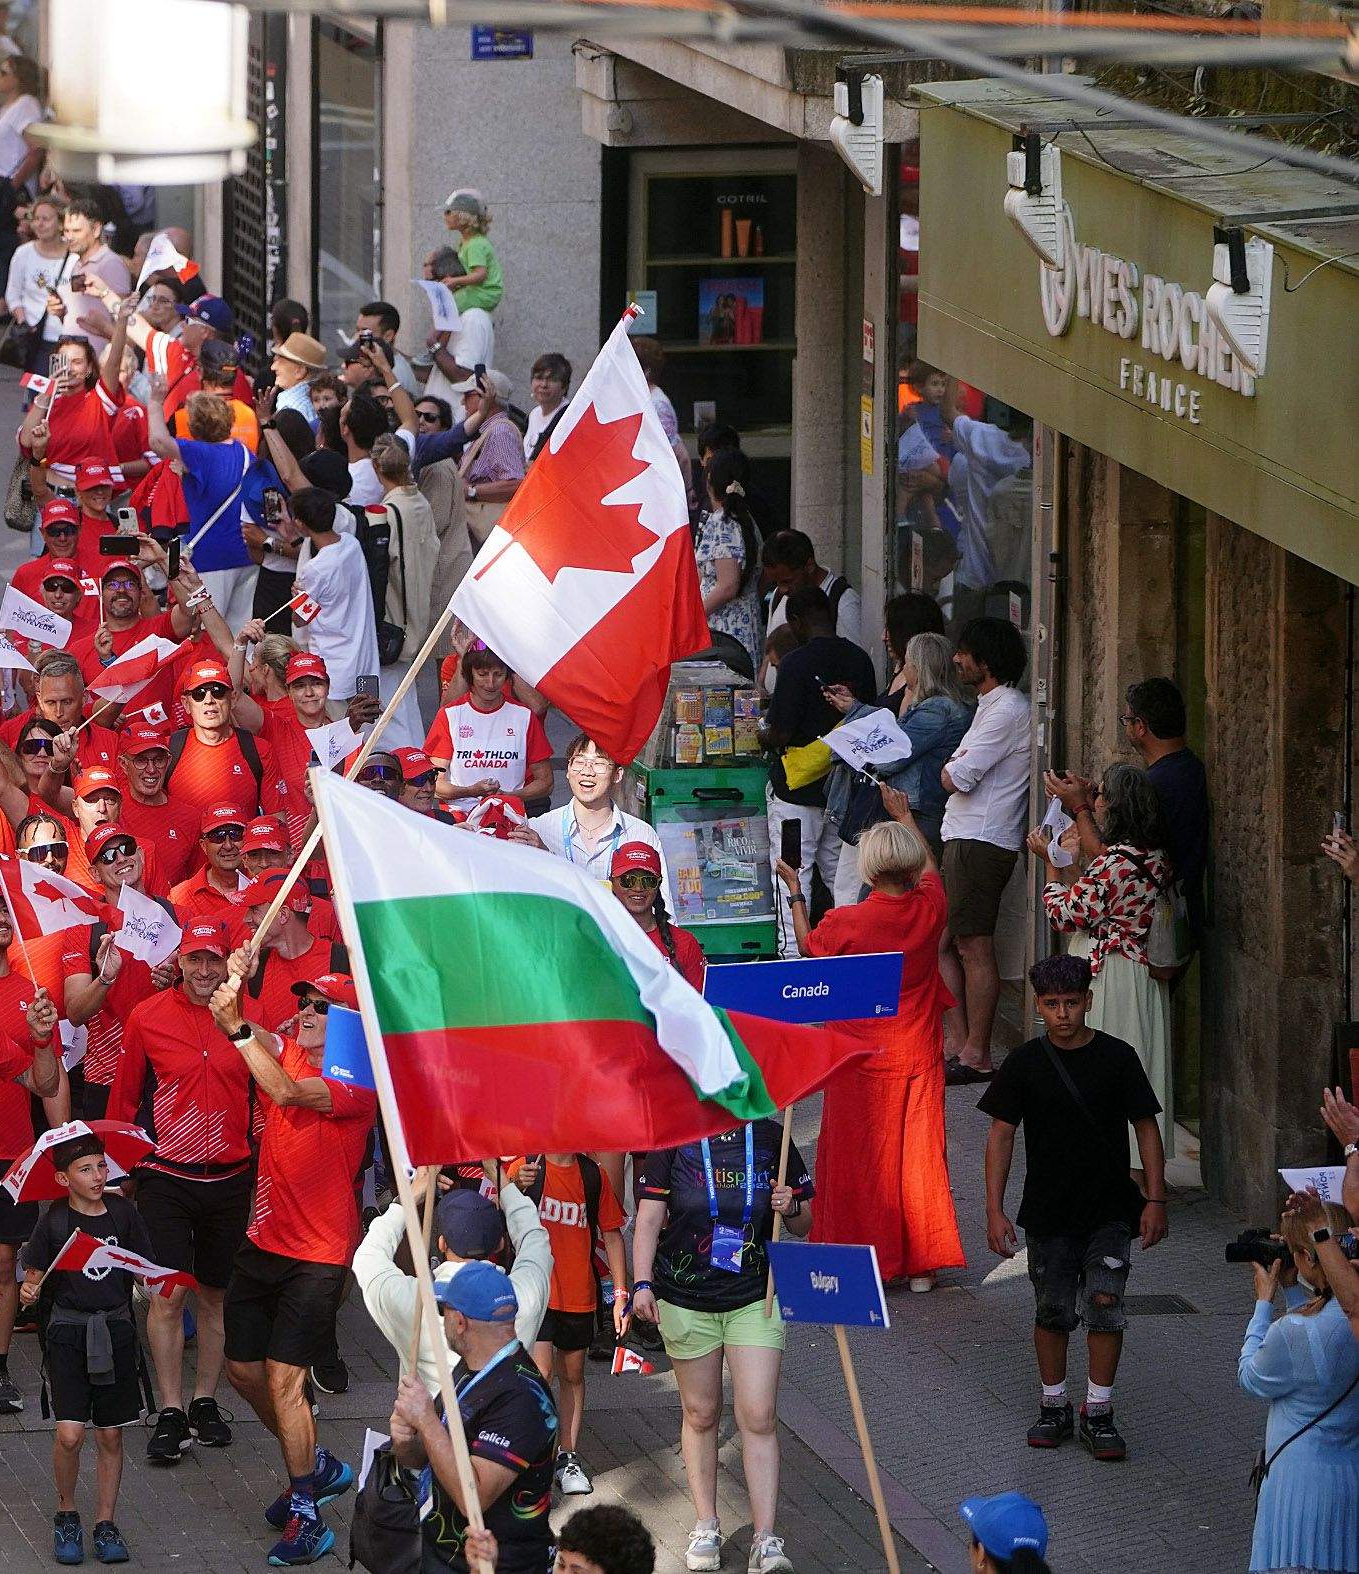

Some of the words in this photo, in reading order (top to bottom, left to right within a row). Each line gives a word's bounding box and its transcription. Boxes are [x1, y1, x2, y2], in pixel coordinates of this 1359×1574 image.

[1075, 242, 1140, 340] YVES
[1120, 357, 1201, 425] FRANCE
[464, 760, 508, 768] CANADA
[782, 982, 830, 999] Canada
[478, 1430, 511, 1448] Galicia
